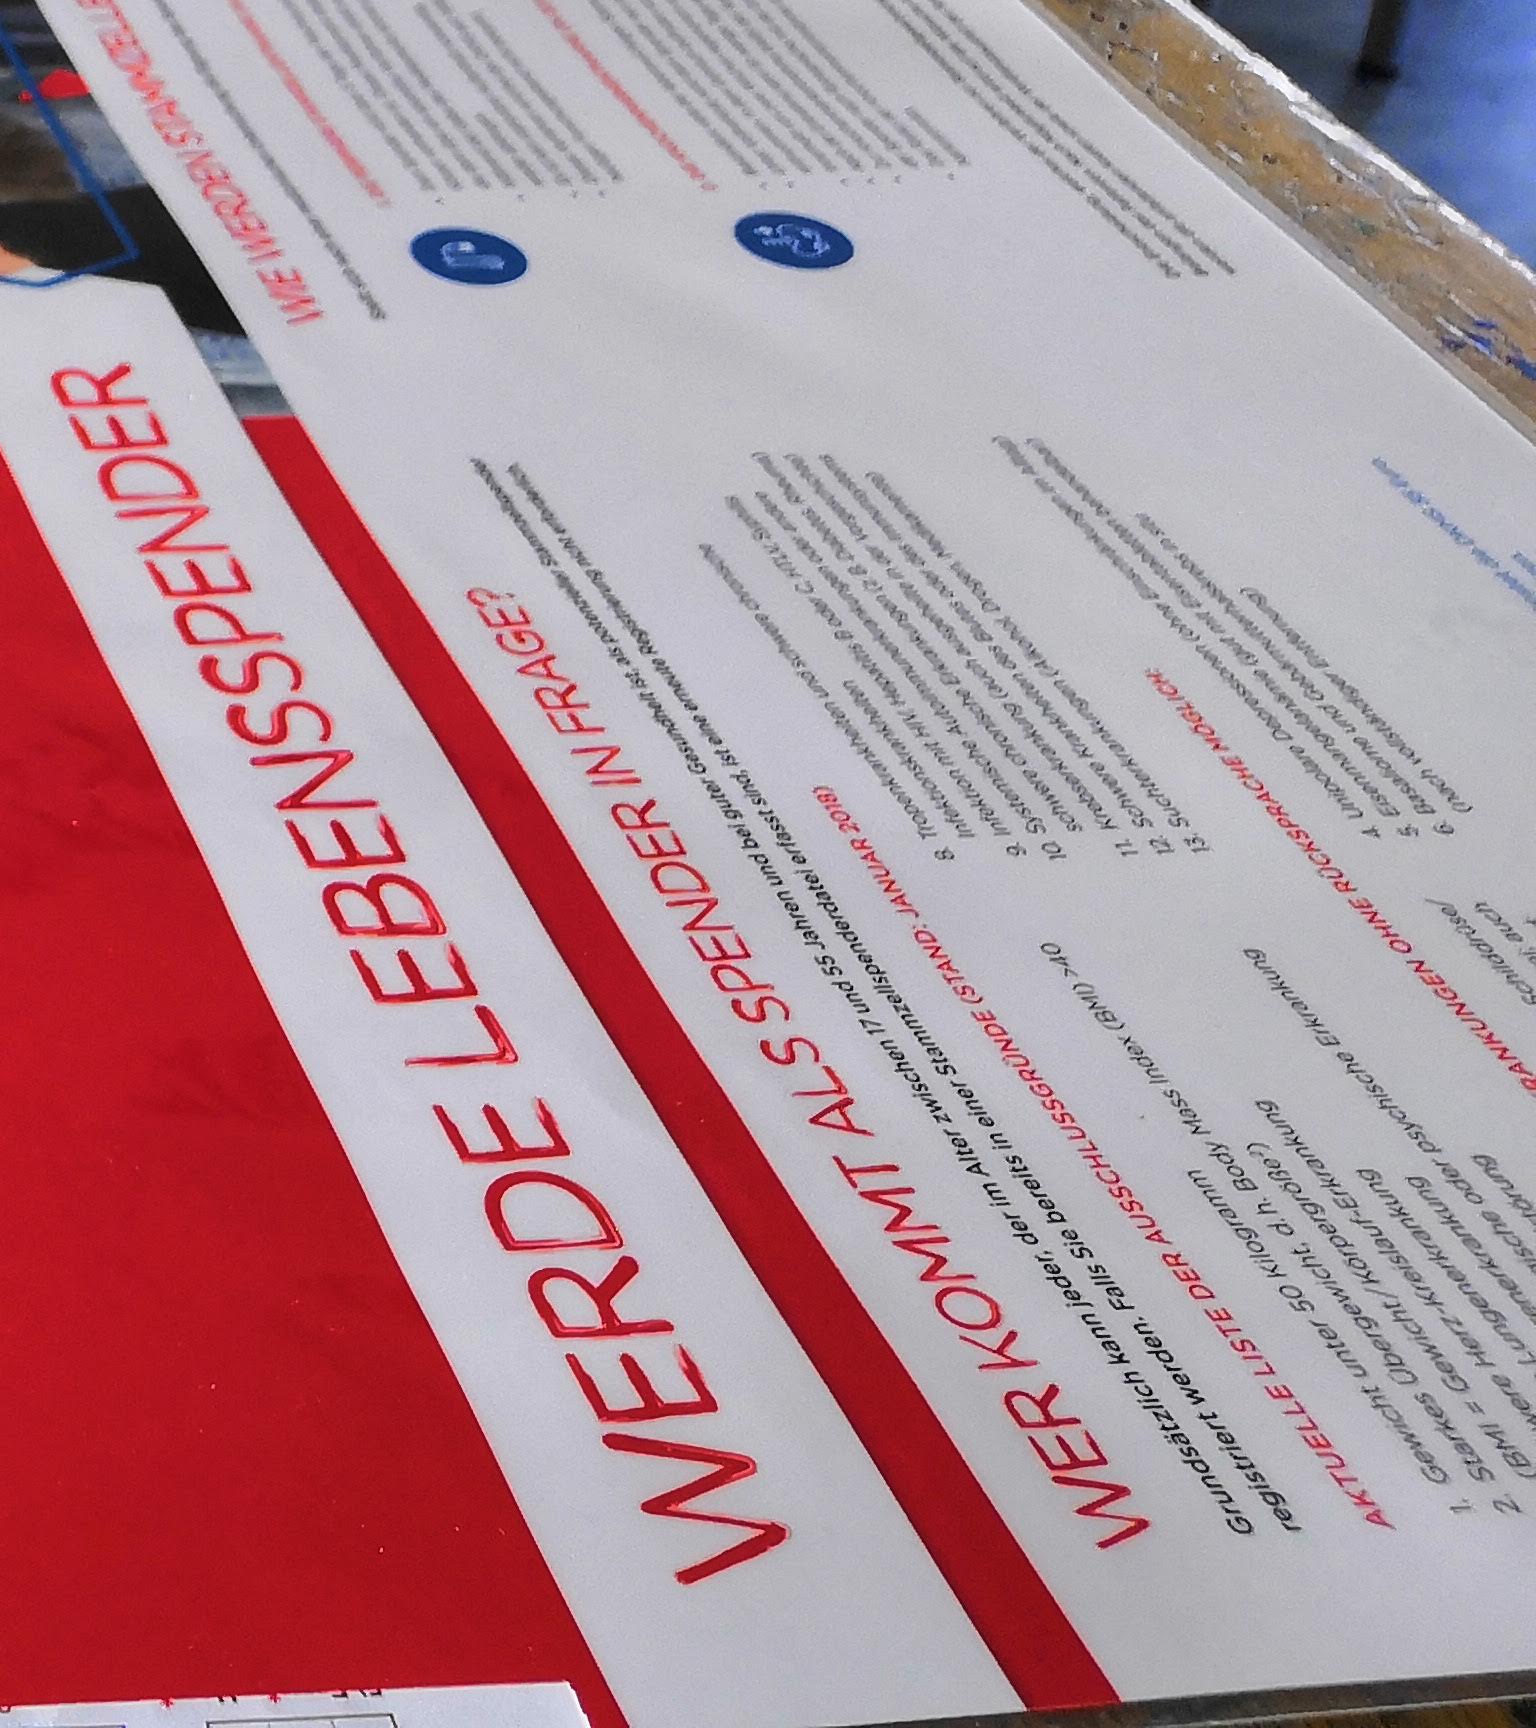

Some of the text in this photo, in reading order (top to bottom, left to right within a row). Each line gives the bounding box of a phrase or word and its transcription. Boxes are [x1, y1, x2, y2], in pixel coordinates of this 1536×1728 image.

[177, 150, 282, 262] WERDEN
[256, 269, 324, 324] WIE
[51, 364, 518, 1067] LEBENSSPENDER
[640, 692, 707, 775] Gesundheit
[714, 749, 739, 766] ist
[701, 778, 743, 820] guter
[730, 770, 768, 806] sind,
[728, 824, 760, 849] bei
[758, 809, 806, 864] erfasst
[1221, 756, 1357, 892] RÜCKSPRACHE
[748, 854, 783, 886] und
[777, 891, 825, 950] Jahren
[1348, 898, 1412, 953] OHNE
[796, 870, 956, 1075] Stammzellspenderdatei
[814, 955, 843, 975] 55
[1040, 943, 1078, 977] >40
[831, 981, 870, 1013] und
[1072, 983, 1125, 1030] (BMI)
[858, 1019, 885, 1035] 17
[467, 588, 1150, 1550] WER KOMMT ALS SPENDER IN FRAGE?
[880, 1040, 952, 1123] zwischen
[1118, 1036, 1169, 1084] Index
[1243, 949, 1485, 1204] oder psychische Erkrankung
[950, 1081, 995, 1127] einer
[1163, 1089, 1211, 1134] Mass
[812, 786, 1395, 1529] AKTUELLE LISTE DER AUSSCHLUSSGRÜNDE (STAND: JANUAR 2018)
[943, 1129, 990, 1177] Alter
[990, 1133, 1012, 1149] in
[1205, 1142, 1258, 1191] Body
[983, 1183, 1011, 1206] im
[1006, 1155, 1067, 1223] bereits
[1003, 1212, 1038, 1245] der
[1061, 1230, 1094, 1258] Sie
[1188, 1170, 1287, 1277] Kilogramm
[1255, 1101, 1496, 1367] Herz-Kreislauf-Erkrankung
[1035, 1251, 1092, 1307] jeder,
[1088, 1265, 1134, 1310] Falls
[1279, 1285, 1315, 1311] 50
[432, 1098, 791, 1585] WERDE
[1081, 1314, 1130, 1364] kann
[1291, 1243, 1418, 1385] Übergewicht,
[1133, 1317, 1205, 1405] werden.
[1309, 1320, 1367, 1377] unter
[1124, 1372, 1254, 1534] Grundsätzlich
[1361, 1386, 1450, 1484] Gewicht
[1414, 1393, 1495, 1482] Starkes
[1197, 1412, 1301, 1531] registriert
